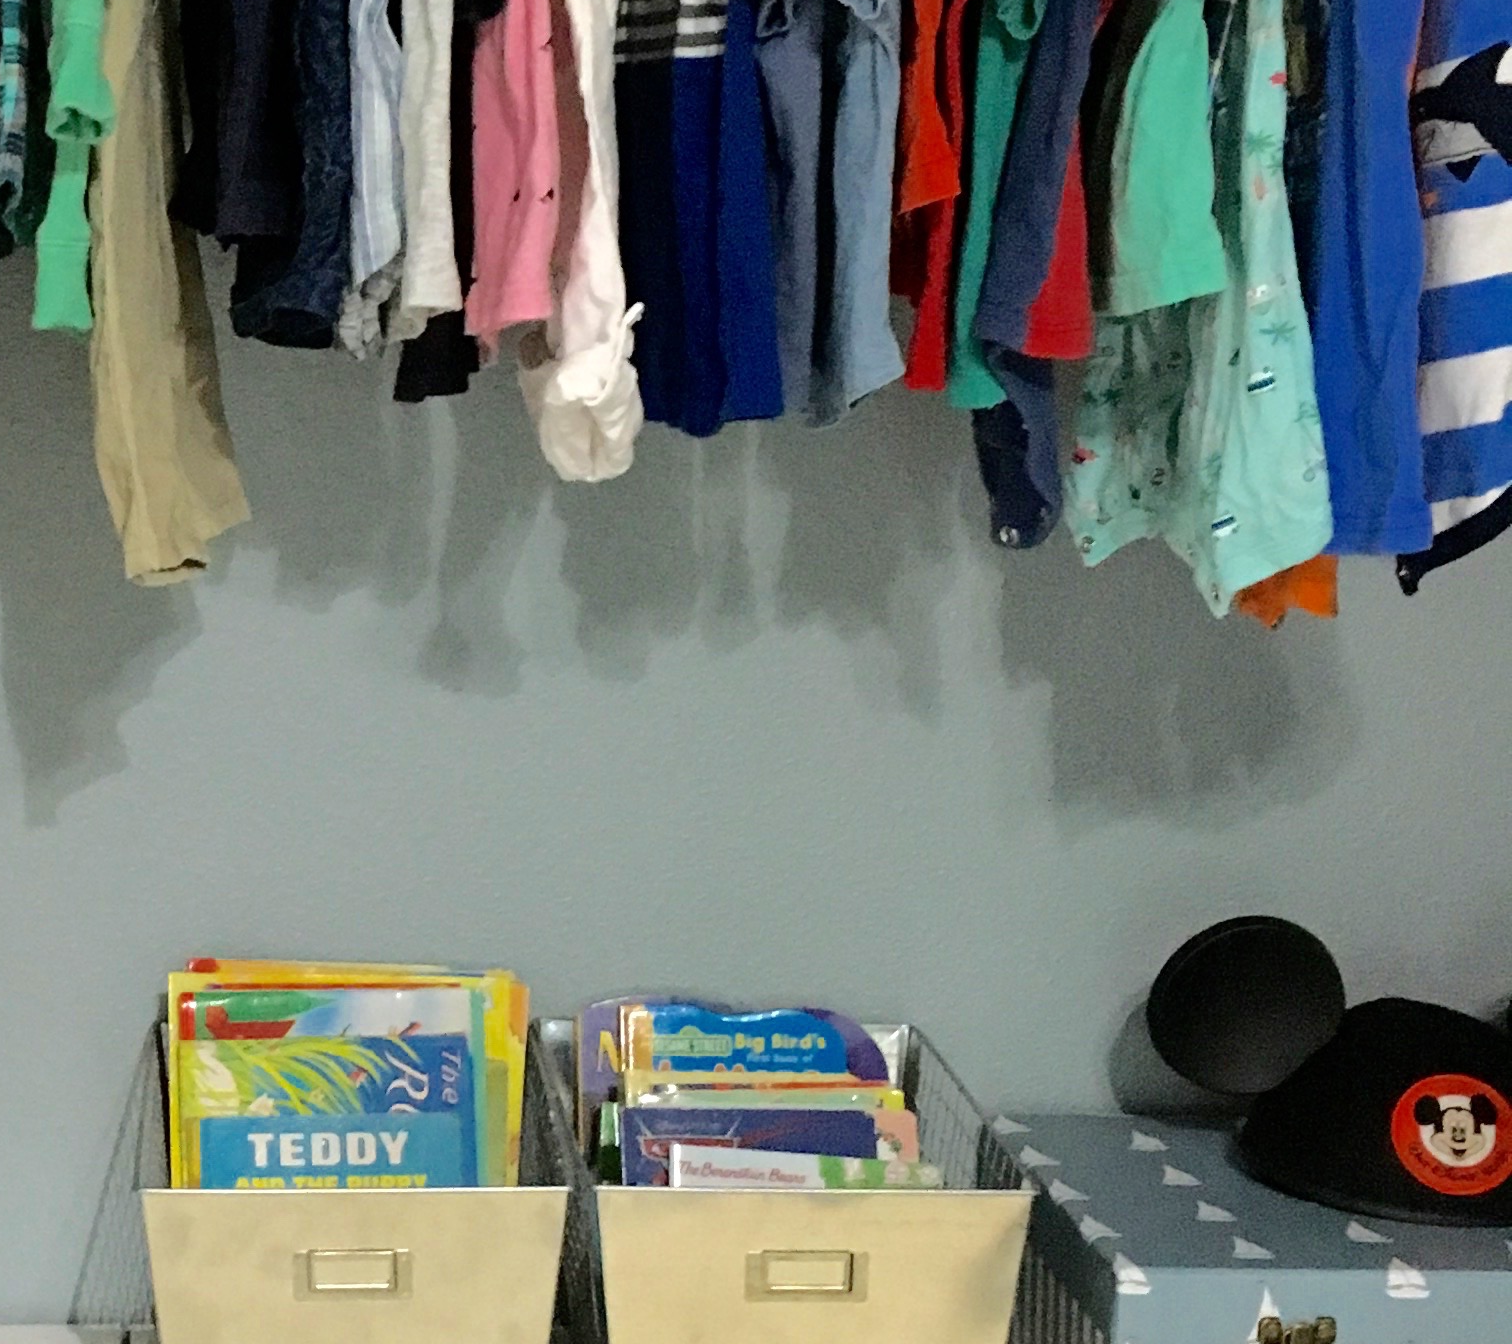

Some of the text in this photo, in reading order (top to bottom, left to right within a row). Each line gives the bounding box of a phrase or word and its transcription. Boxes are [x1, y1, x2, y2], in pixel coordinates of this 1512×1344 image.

[438, 1050, 464, 1106] The
[247, 1131, 409, 1168] TEDDY
[679, 1160, 700, 1176] The
